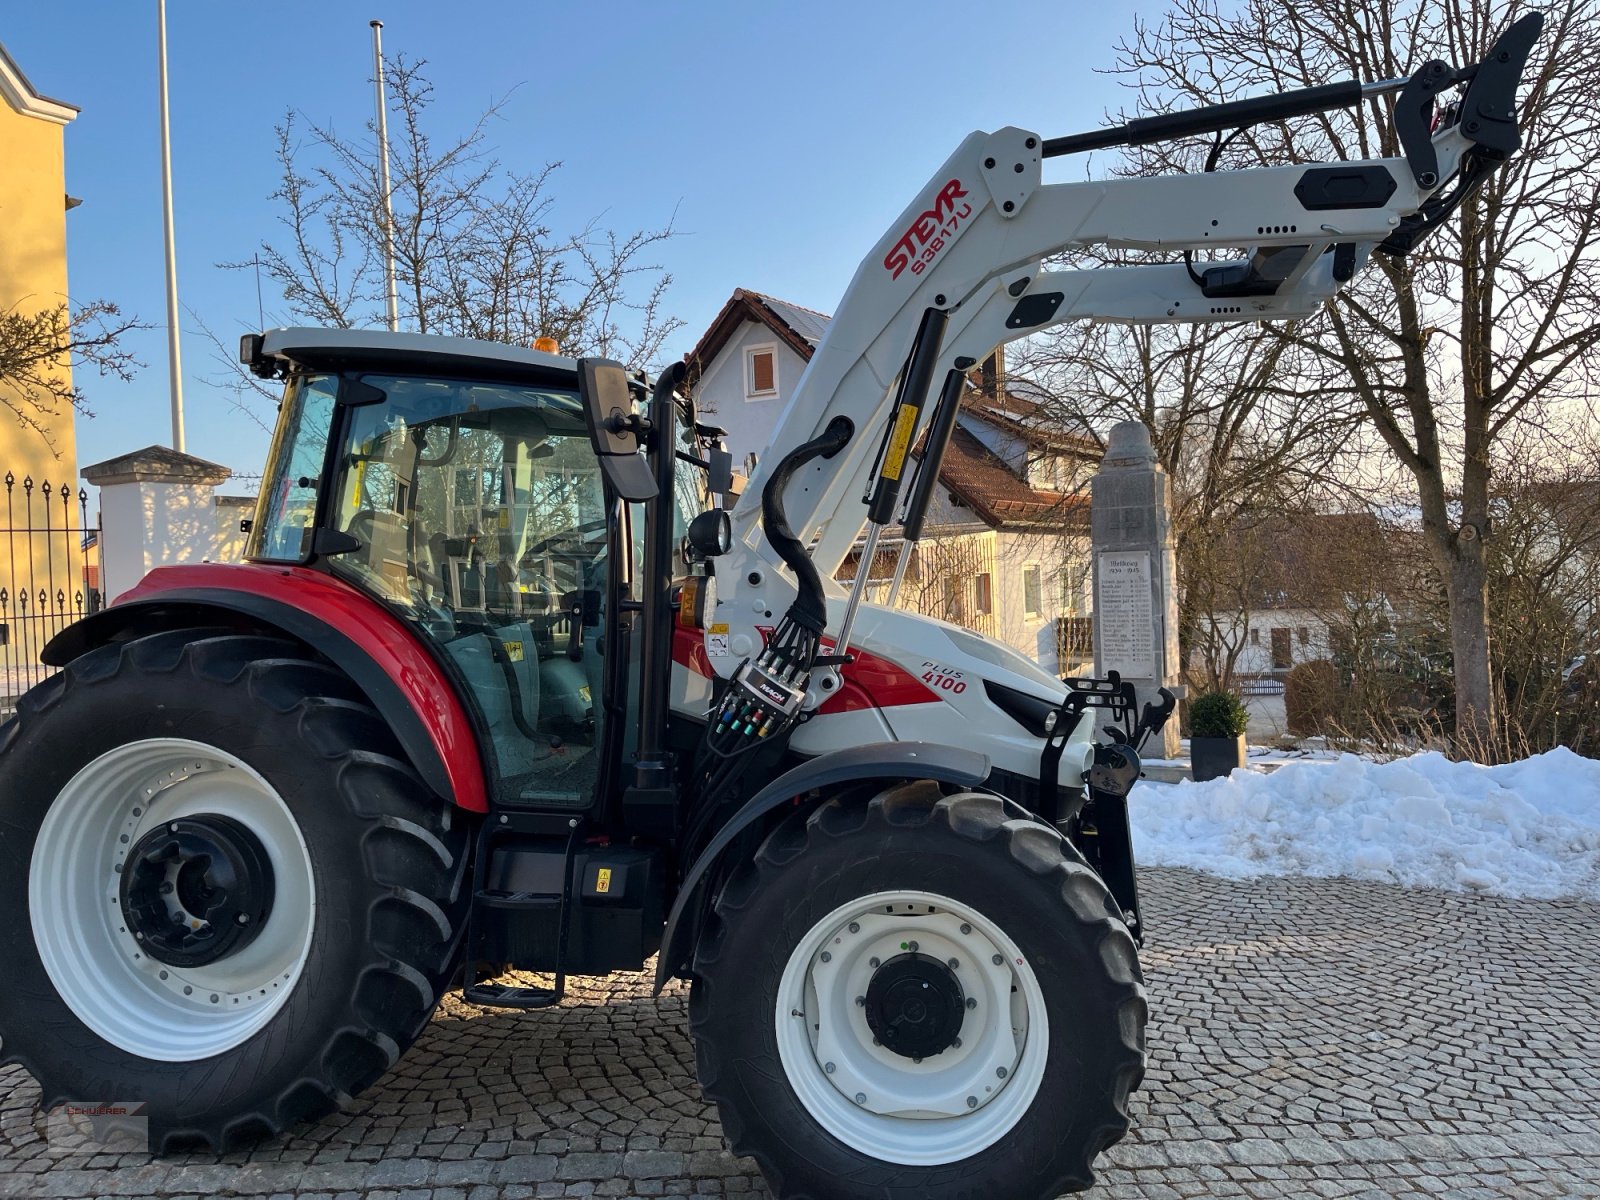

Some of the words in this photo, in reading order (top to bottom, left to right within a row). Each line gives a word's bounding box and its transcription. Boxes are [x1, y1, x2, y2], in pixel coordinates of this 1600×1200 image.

[884, 179, 969, 281] STEYR
[911, 203, 972, 275] S3817U
[921, 661, 964, 679] PLUS
[759, 683, 785, 702] MACH
[921, 671, 967, 694] 4100
